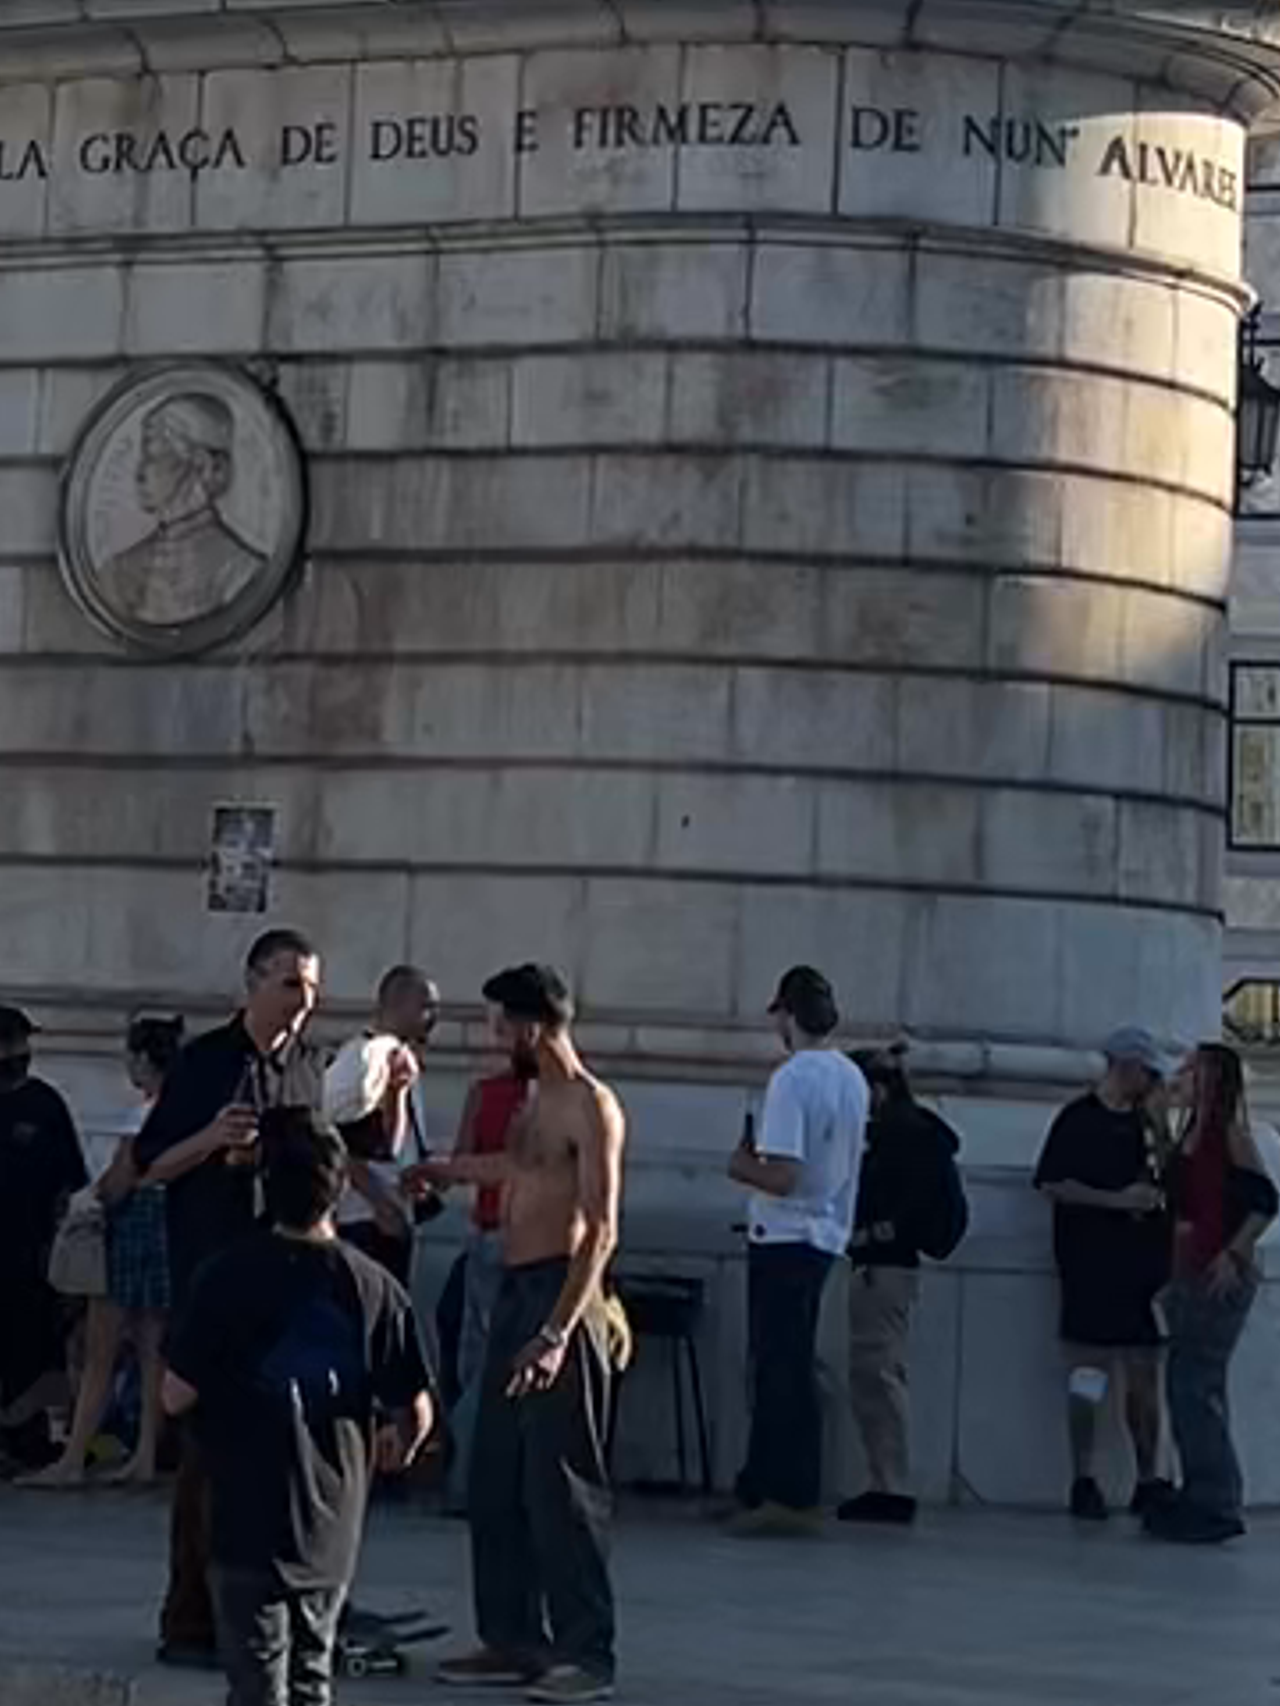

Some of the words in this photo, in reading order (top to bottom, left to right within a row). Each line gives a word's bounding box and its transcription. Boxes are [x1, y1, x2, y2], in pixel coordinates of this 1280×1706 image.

[78, 126, 245, 182] GRAÇA
[280, 122, 338, 166] DE
[370, 115, 480, 160] DEUS
[513, 110, 540, 153] E
[572, 100, 801, 150] FIRMEZA
[850, 106, 920, 153] DE
